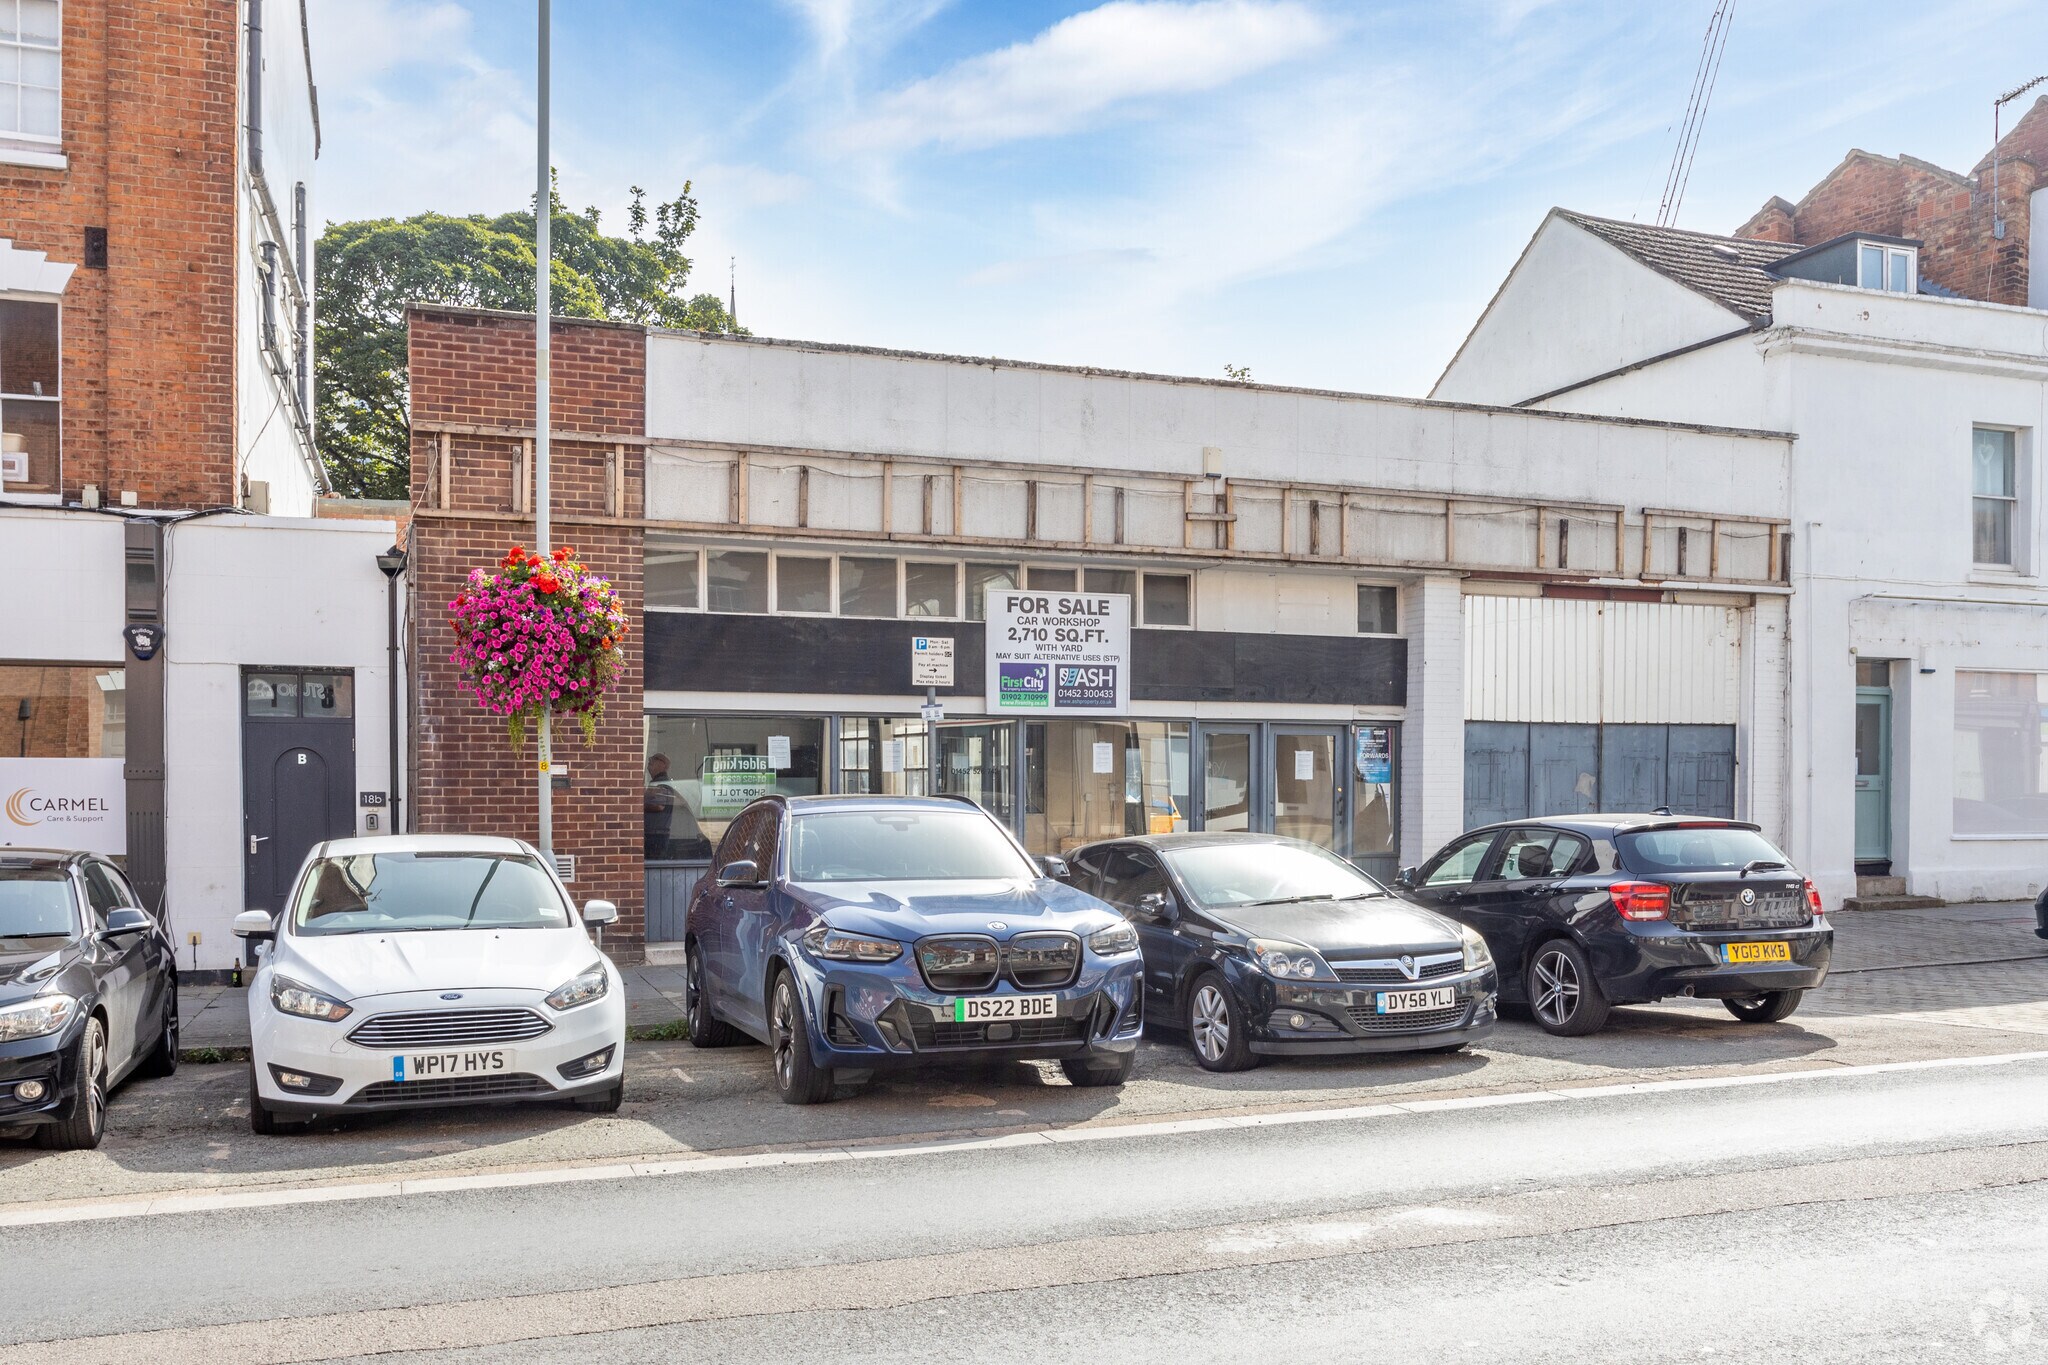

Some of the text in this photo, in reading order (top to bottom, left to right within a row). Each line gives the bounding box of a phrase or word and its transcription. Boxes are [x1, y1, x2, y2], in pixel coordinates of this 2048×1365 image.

[1007, 596, 1110, 616] FOR SALE
[1017, 616, 1100, 627] CAR WORKSHOP
[1008, 627, 1109, 643] 2,710 SQ.FT.
[1035, 644, 1057, 652] WITH
[1103, 655, 1120, 663] (STP)
[1074, 668, 1113, 687] ASH
[1058, 689, 1113, 698] 01452 300433
[297, 753, 307, 764] B
[30, 798, 109, 811] CARMEL
[363, 795, 382, 804] 18b
[73, 815, 104, 823] Support
[1732, 944, 1786, 959] YG13 KKB
[1388, 989, 1453, 1009] DY58 YLJ
[968, 998, 1053, 1018] DS22 BDE
[413, 1051, 504, 1074] WP17 HYS
